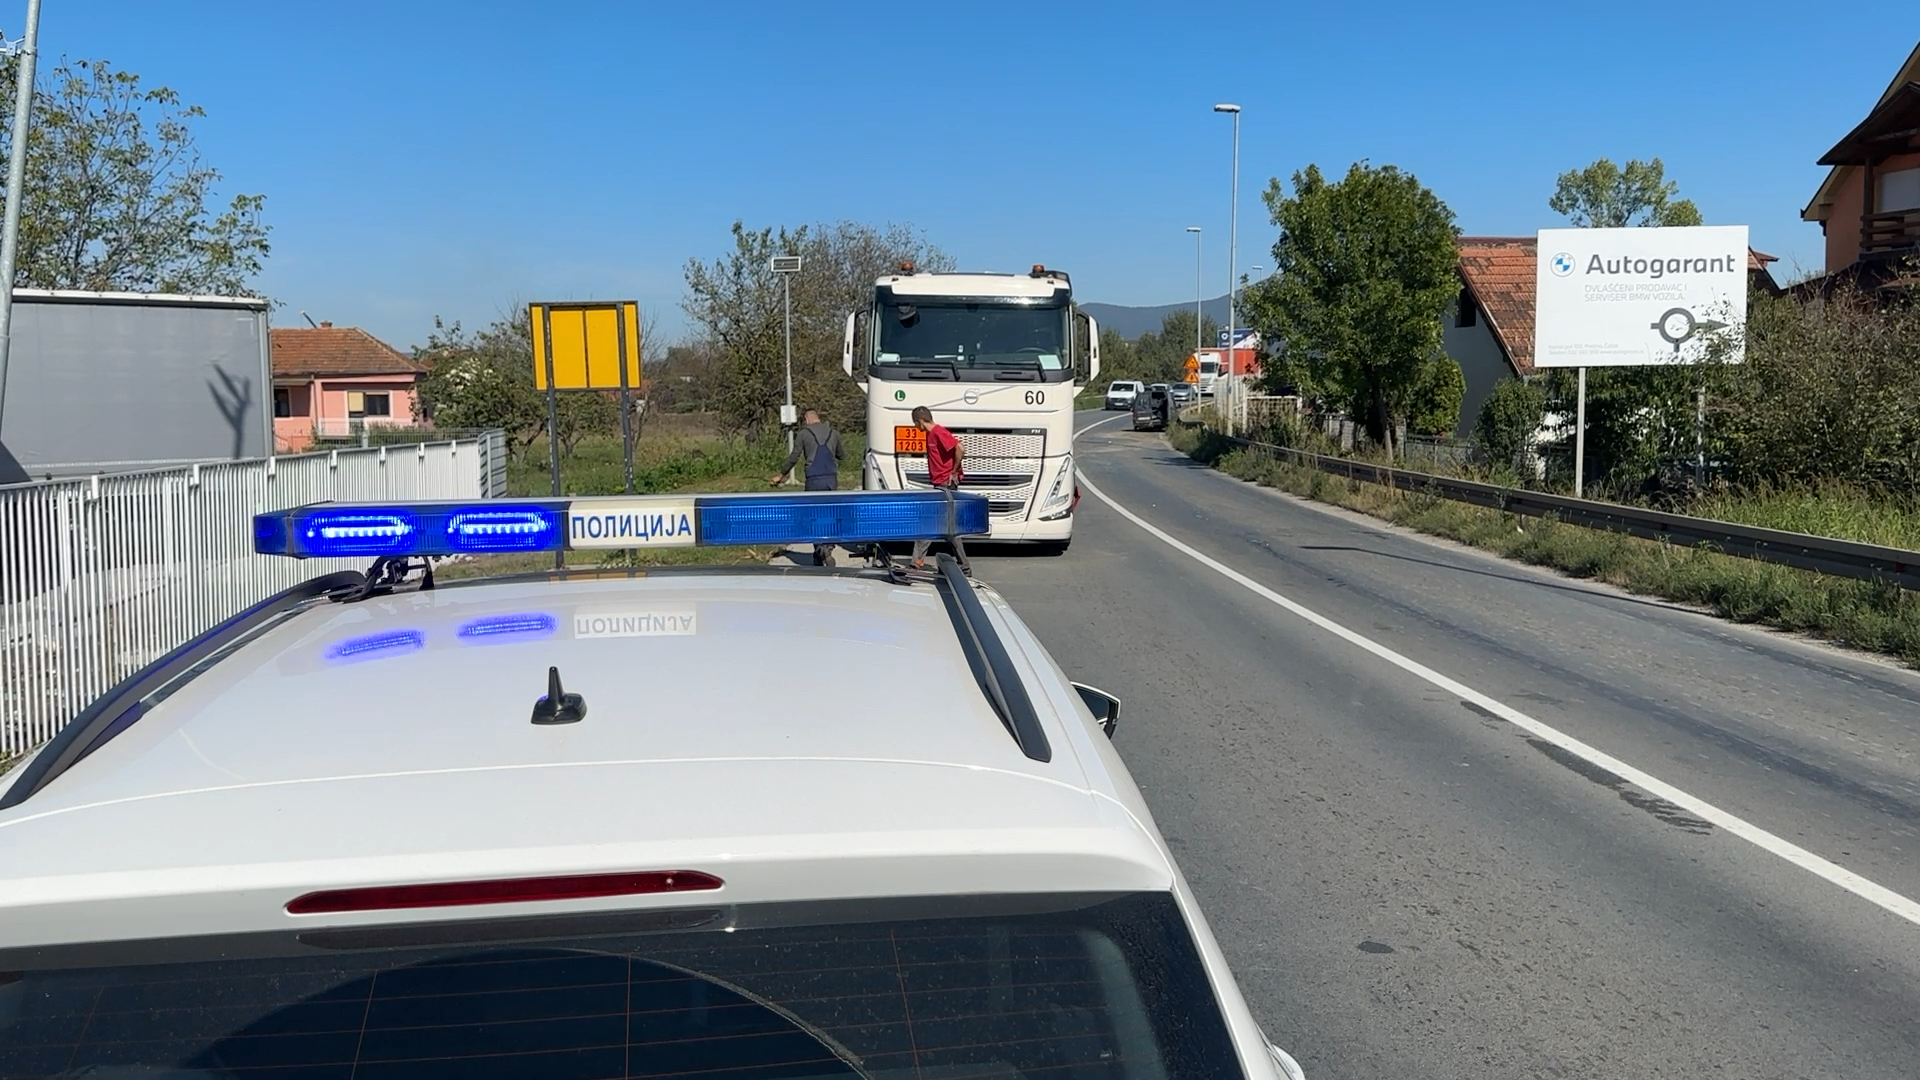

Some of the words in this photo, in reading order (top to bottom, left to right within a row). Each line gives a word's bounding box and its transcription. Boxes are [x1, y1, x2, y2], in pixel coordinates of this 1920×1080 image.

[1586, 254, 1735, 279] Autogarant
[1636, 283, 1683, 292] PRODAVAC
[1584, 293, 1628, 302] SERVISER
[1629, 293, 1651, 301] BMW
[1025, 391, 1045, 405] 60
[905, 428, 917, 439] 33
[899, 441, 923, 451] 1203
[572, 514, 692, 541] ПОЛИЦИЈА
